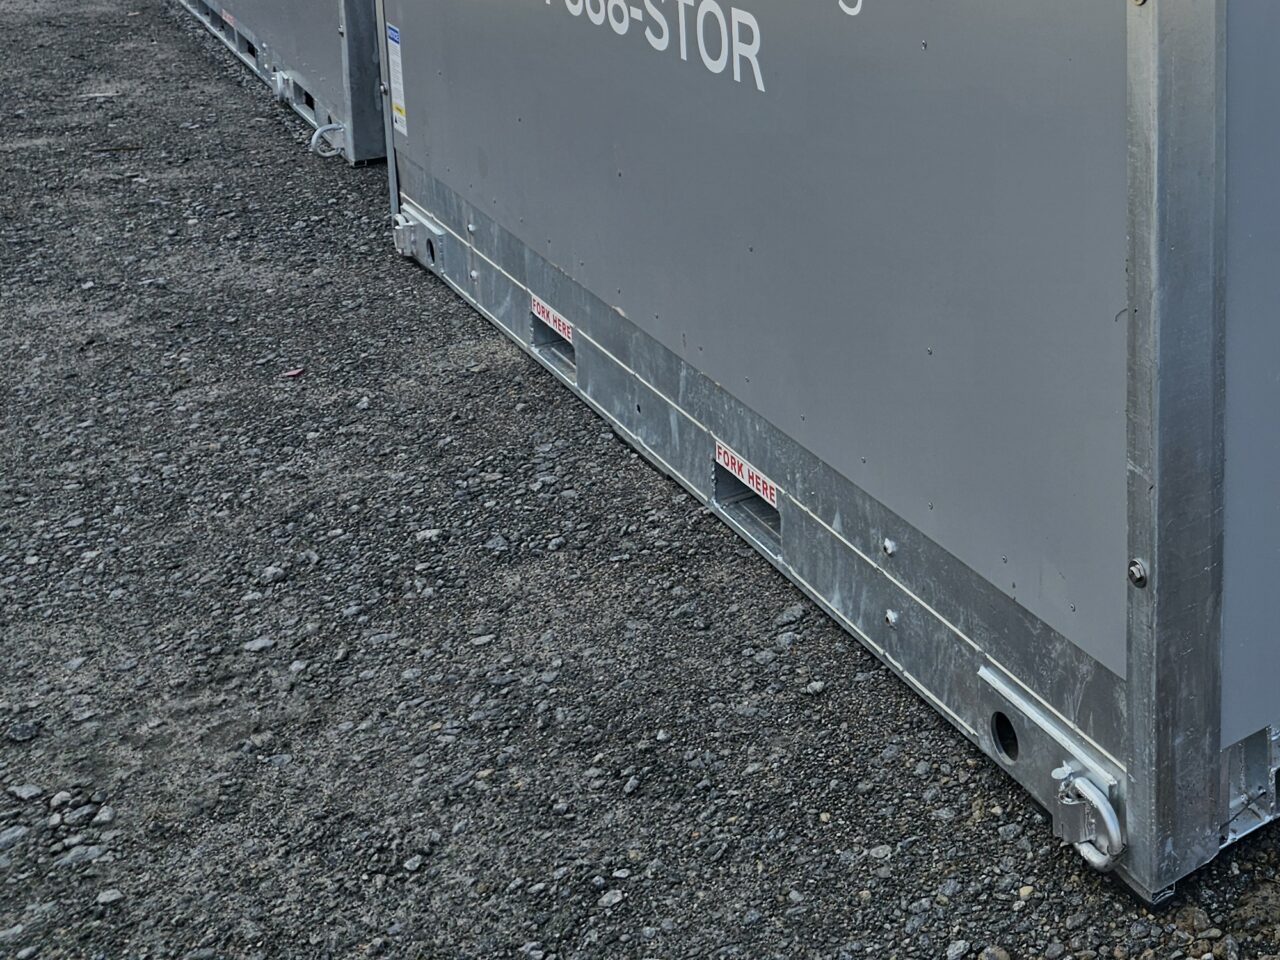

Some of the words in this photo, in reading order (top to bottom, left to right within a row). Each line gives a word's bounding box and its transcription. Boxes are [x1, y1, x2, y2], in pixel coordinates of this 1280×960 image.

[532, 298, 551, 322] FORK
[552, 314, 572, 340] HERE
[717, 444, 744, 479] FORK
[748, 465, 776, 505] HERE
